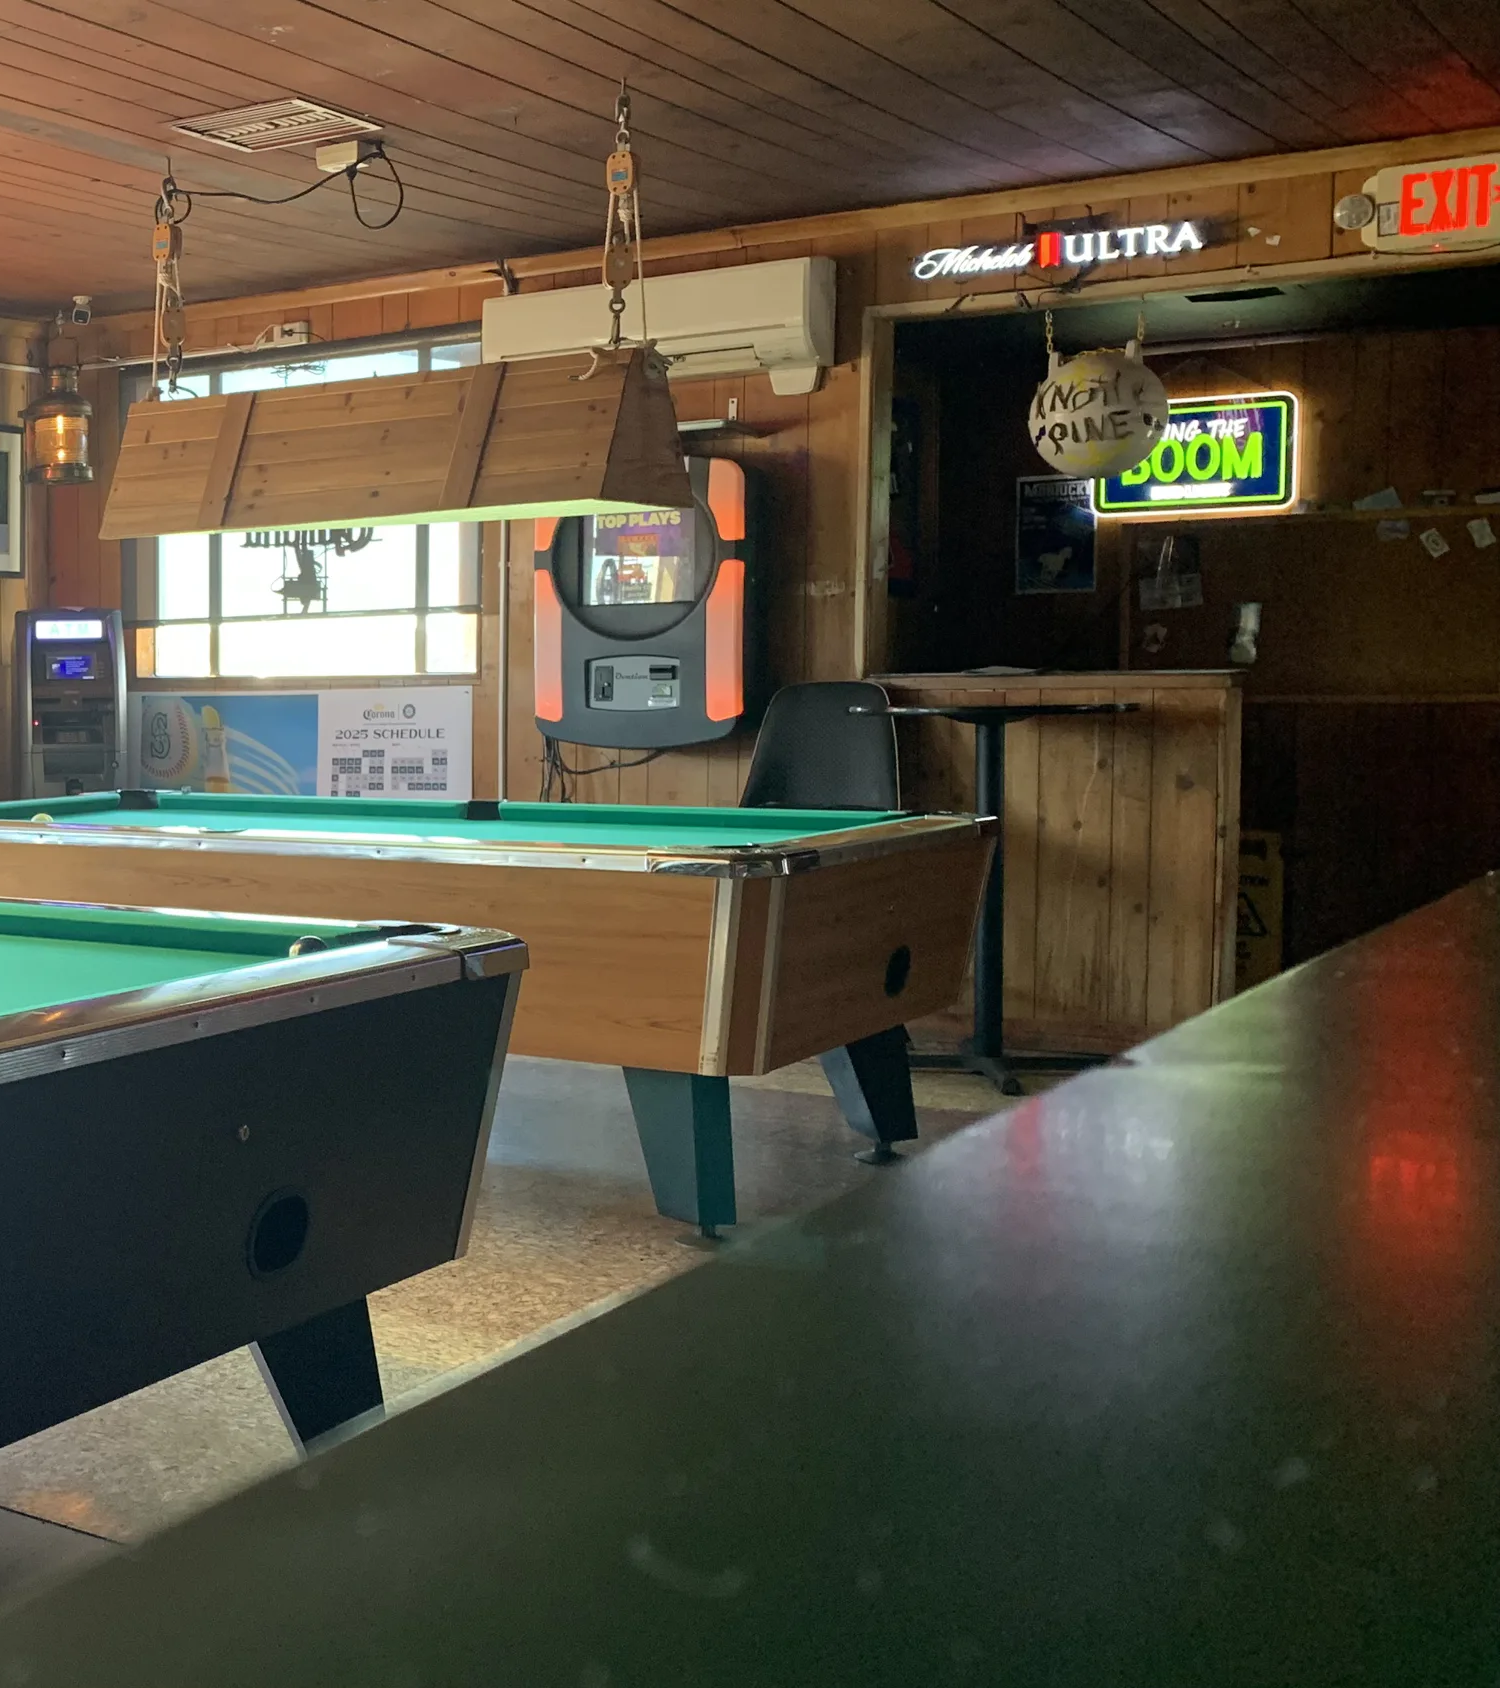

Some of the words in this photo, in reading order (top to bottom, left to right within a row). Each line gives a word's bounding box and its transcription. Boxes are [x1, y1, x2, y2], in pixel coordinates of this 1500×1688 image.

[1399, 163, 1498, 236] EXIT
[914, 244, 1034, 279] Michelob
[1063, 221, 1203, 263] ULTRA
[1048, 410, 1134, 455] PINE
[1206, 418, 1248, 439] THE
[597, 515, 626, 529] TOP
[628, 511, 681, 527] PLAYS
[363, 709, 396, 721] Corona
[335, 729, 369, 740] 2025
[373, 728, 446, 740] SCHEDULE
